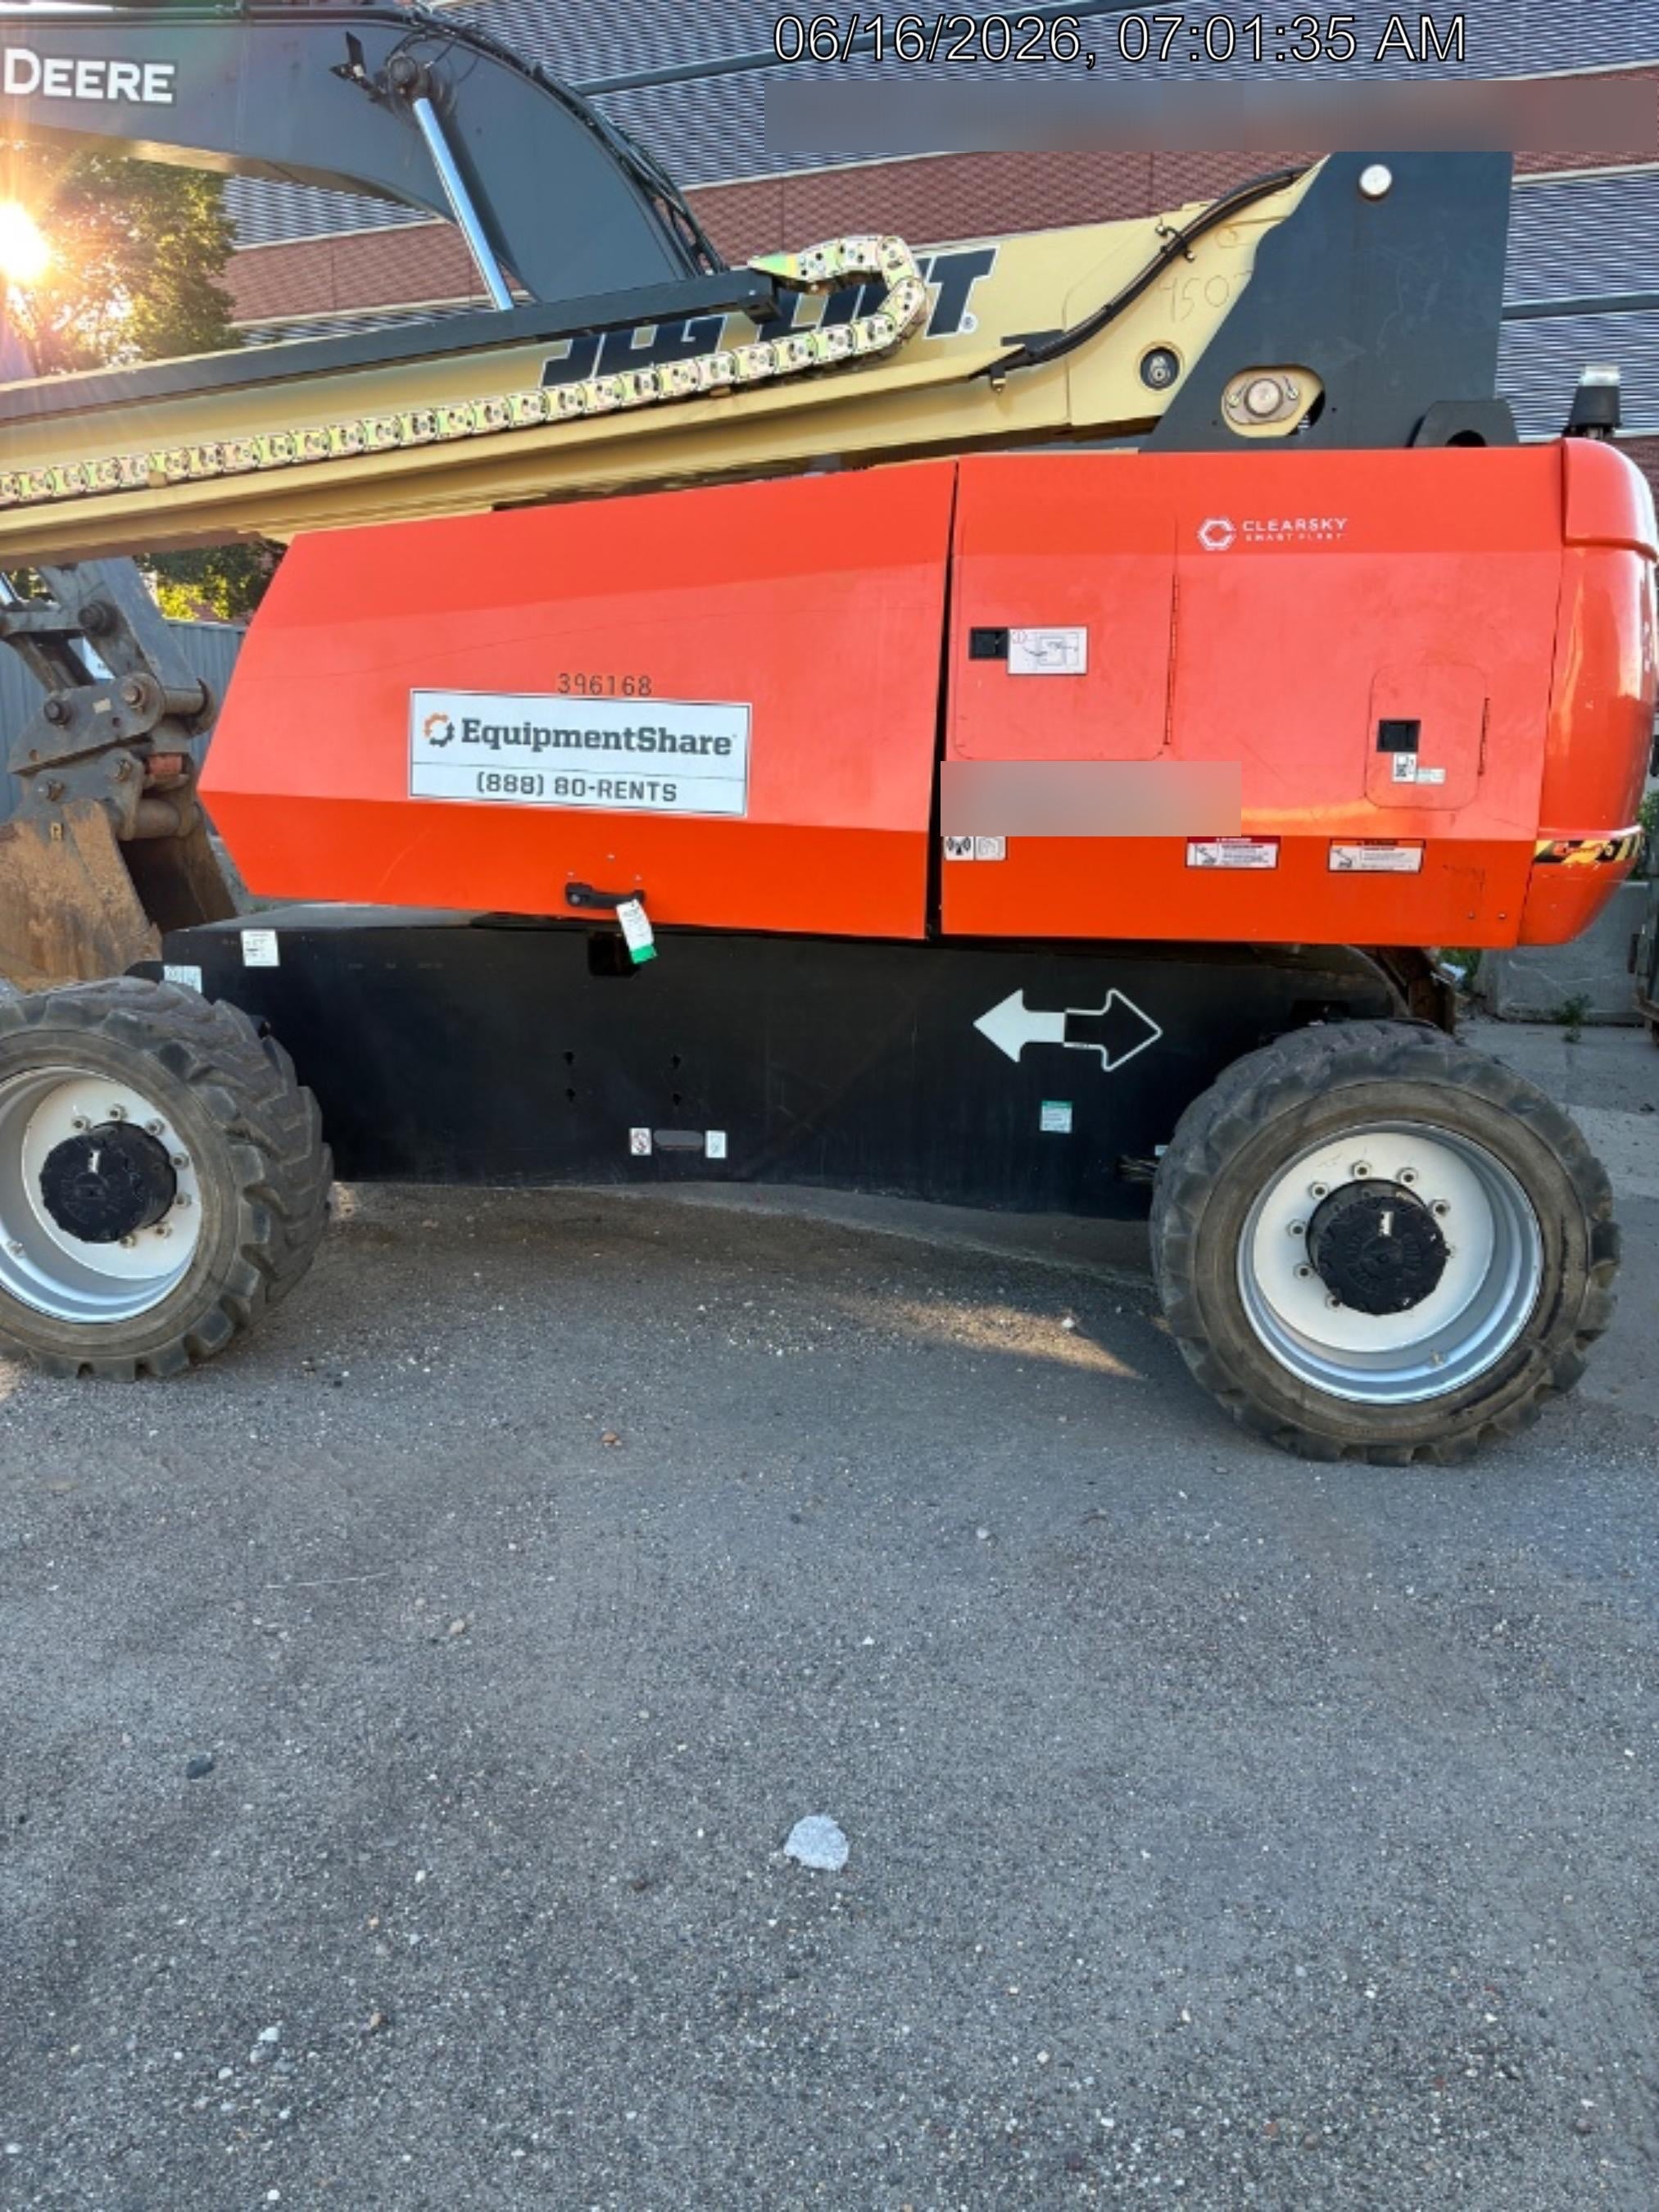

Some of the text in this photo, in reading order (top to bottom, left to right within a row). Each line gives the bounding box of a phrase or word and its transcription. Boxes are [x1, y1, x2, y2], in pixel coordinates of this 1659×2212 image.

[3, 48, 175, 104] DEERE
[1243, 517, 1348, 533] CLEARSKY
[557, 673, 652, 696] 396168
[460, 718, 732, 755] EquipmentShare
[477, 771, 678, 802] (888) 80-RENTS
